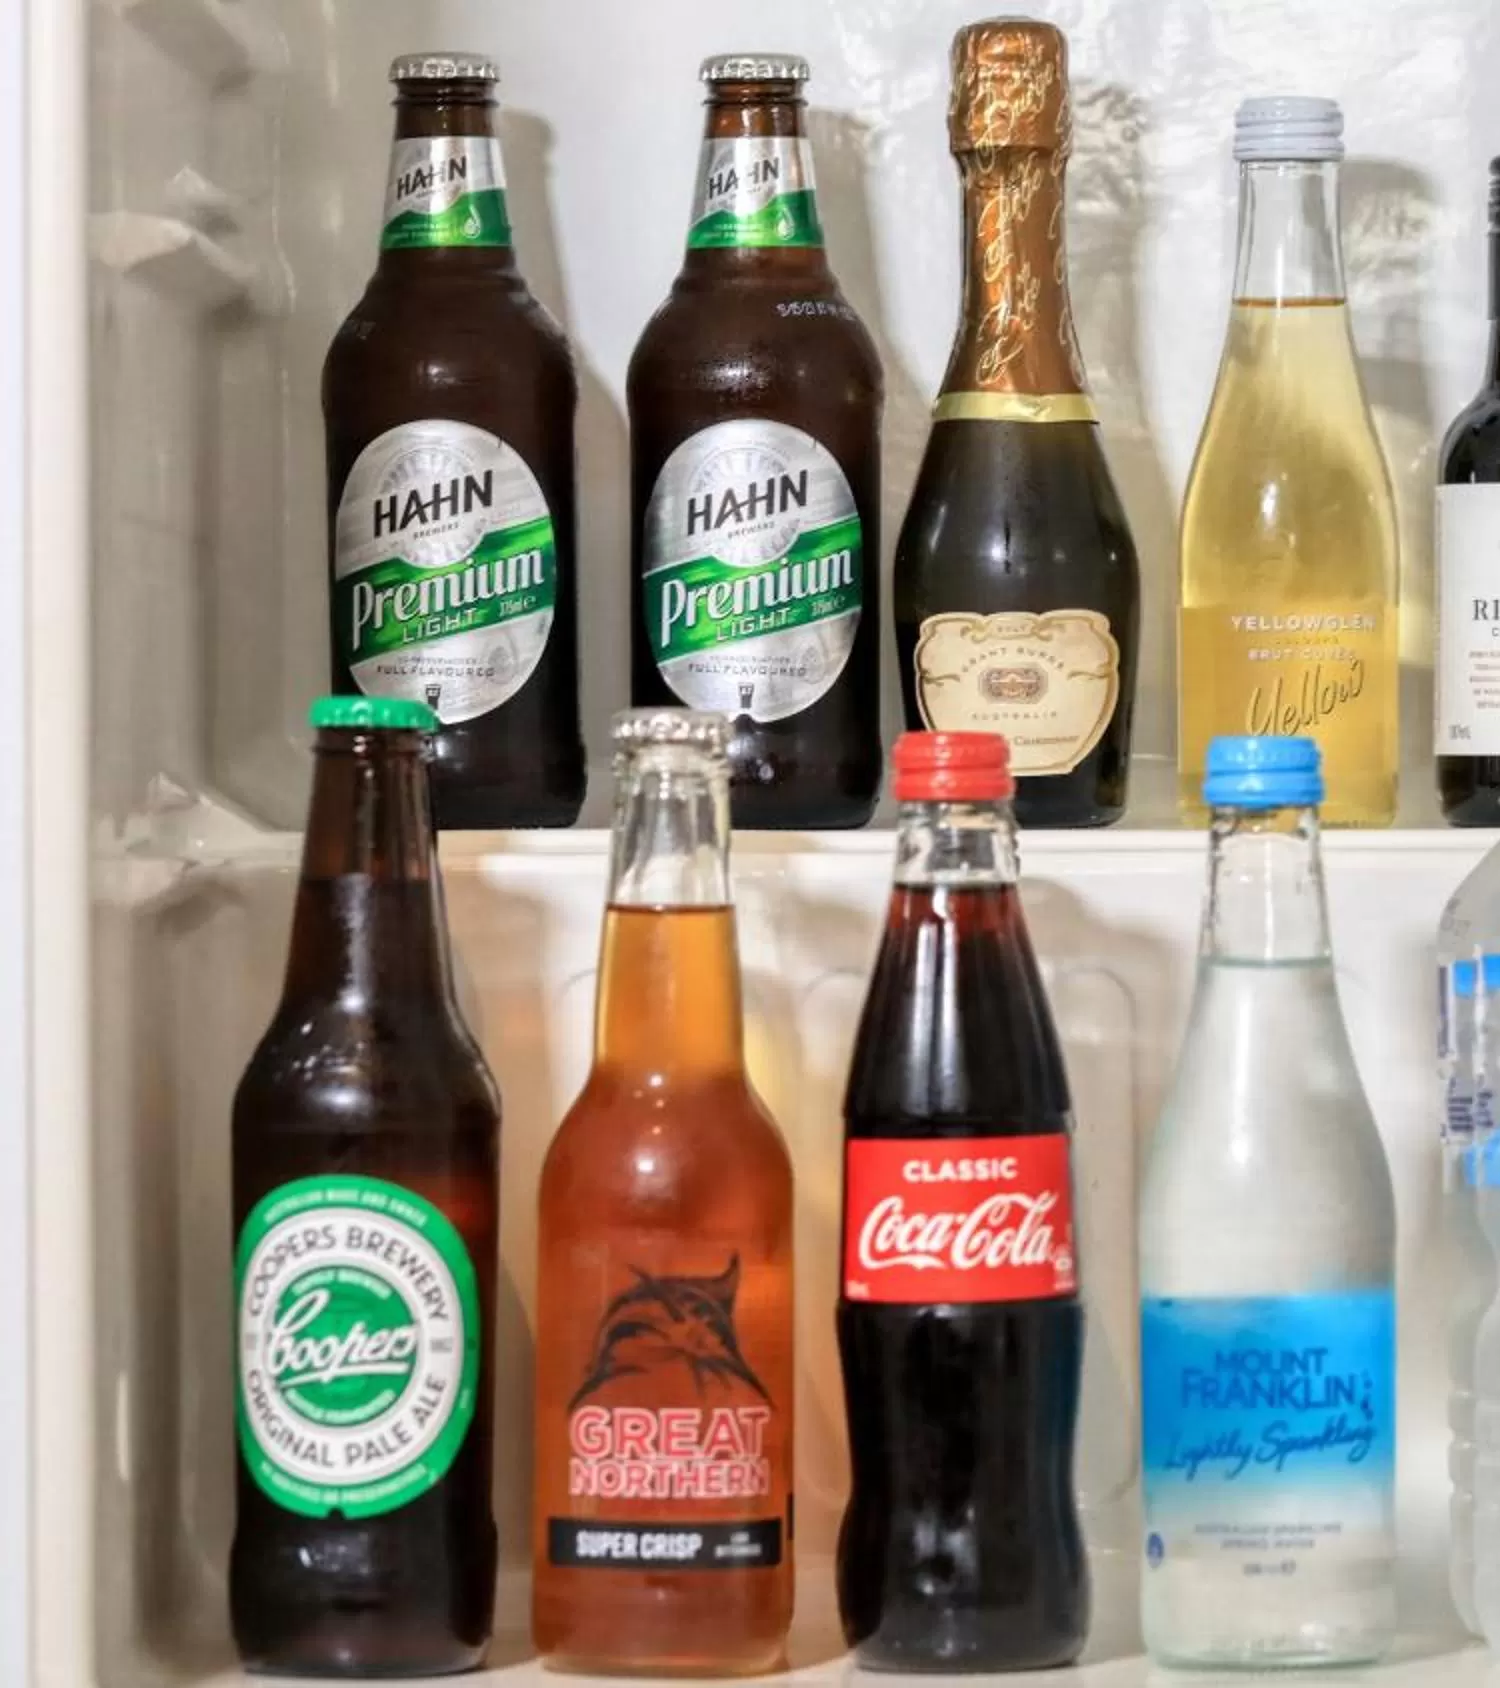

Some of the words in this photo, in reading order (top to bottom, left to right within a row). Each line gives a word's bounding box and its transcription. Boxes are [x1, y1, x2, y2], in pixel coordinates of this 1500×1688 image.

[396, 156, 468, 201] HAHN
[373, 469, 494, 539] HAHN
[686, 469, 809, 537] HAHN
[352, 548, 545, 651] Premium
[660, 548, 854, 649] Premium
[1231, 614, 1377, 632] YELLOWGLEN
[401, 606, 478, 643] LIGHT
[715, 607, 791, 642] LIGHT
[1246, 657, 1366, 738] Yellow
[903, 1156, 1019, 1183] CLASSIC
[858, 1190, 1061, 1272] Coca-Cola
[249, 1224, 337, 1317] COOPERS
[346, 1225, 451, 1323] BREWERY
[1213, 1346, 1329, 1376] MOUNT
[1181, 1365, 1357, 1412] FRANKLIN
[249, 1368, 336, 1468] ORIGINAL
[345, 1421, 414, 1467] PALE
[416, 1374, 447, 1429] ALE
[568, 1404, 772, 1460] GREAT
[567, 1456, 771, 1501] NORTHERN
[575, 1529, 638, 1560] SUPER
[639, 1530, 704, 1560] CRISP
